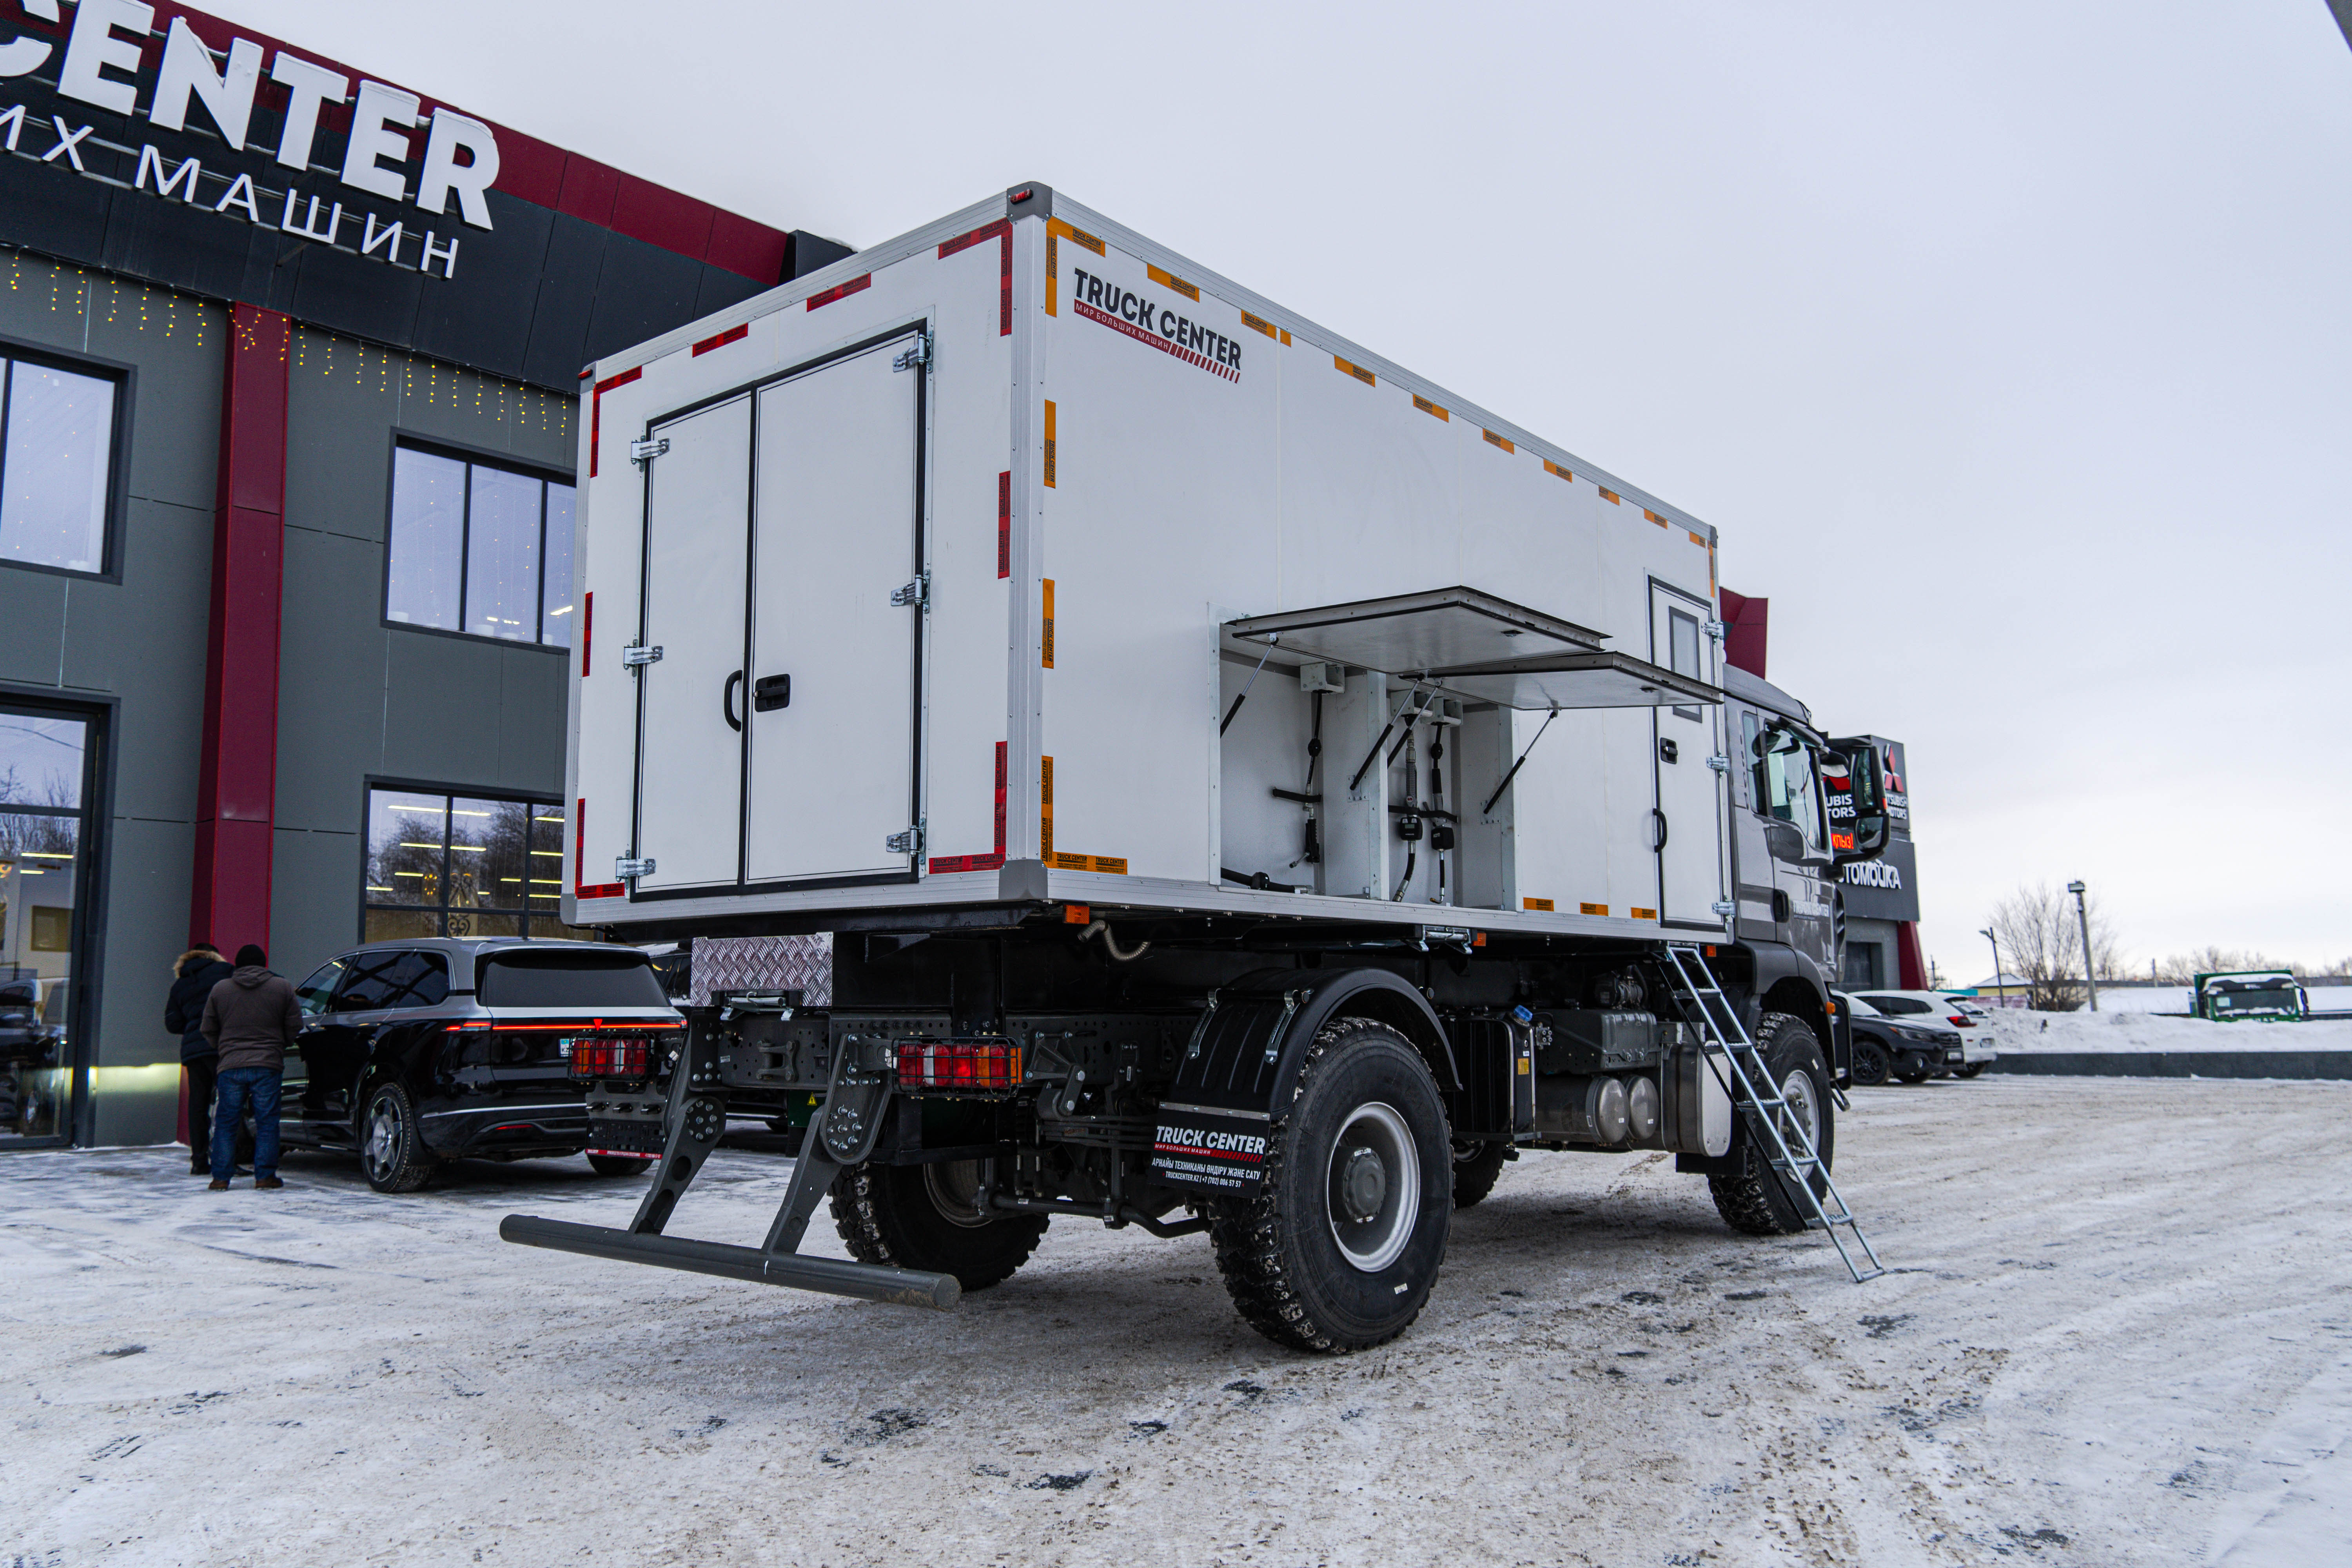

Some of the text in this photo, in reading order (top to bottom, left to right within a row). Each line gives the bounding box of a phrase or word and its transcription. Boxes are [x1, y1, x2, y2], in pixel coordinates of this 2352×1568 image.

[135, 145, 459, 279] МАШИН
[1073, 229, 1085, 239] TRUCK
[1086, 235, 1101, 246] CENTER
[1171, 276, 1182, 285] TRUCK
[1183, 283, 1195, 292] CENTER
[1074, 267, 1155, 331] TRUCK
[1160, 310, 1241, 370] CENTER
[1076, 303, 1168, 350] МИР БОЛЬШИХ МАШИН
[1828, 806, 1856, 818] TORS
[1838, 858, 1902, 889] ТОМОЙКА
[1156, 1126, 1265, 1154] TRUCK CENTER
[1152, 1158, 1260, 1180] АРНАЙЫ ТЕХНИКАНЫ ӨНДІРУ ЖӘНЕ САТУ
[1165, 1171, 1199, 1182] TRUCKCENTER.KZ
[1208, 1176, 1219, 1186] (702)
